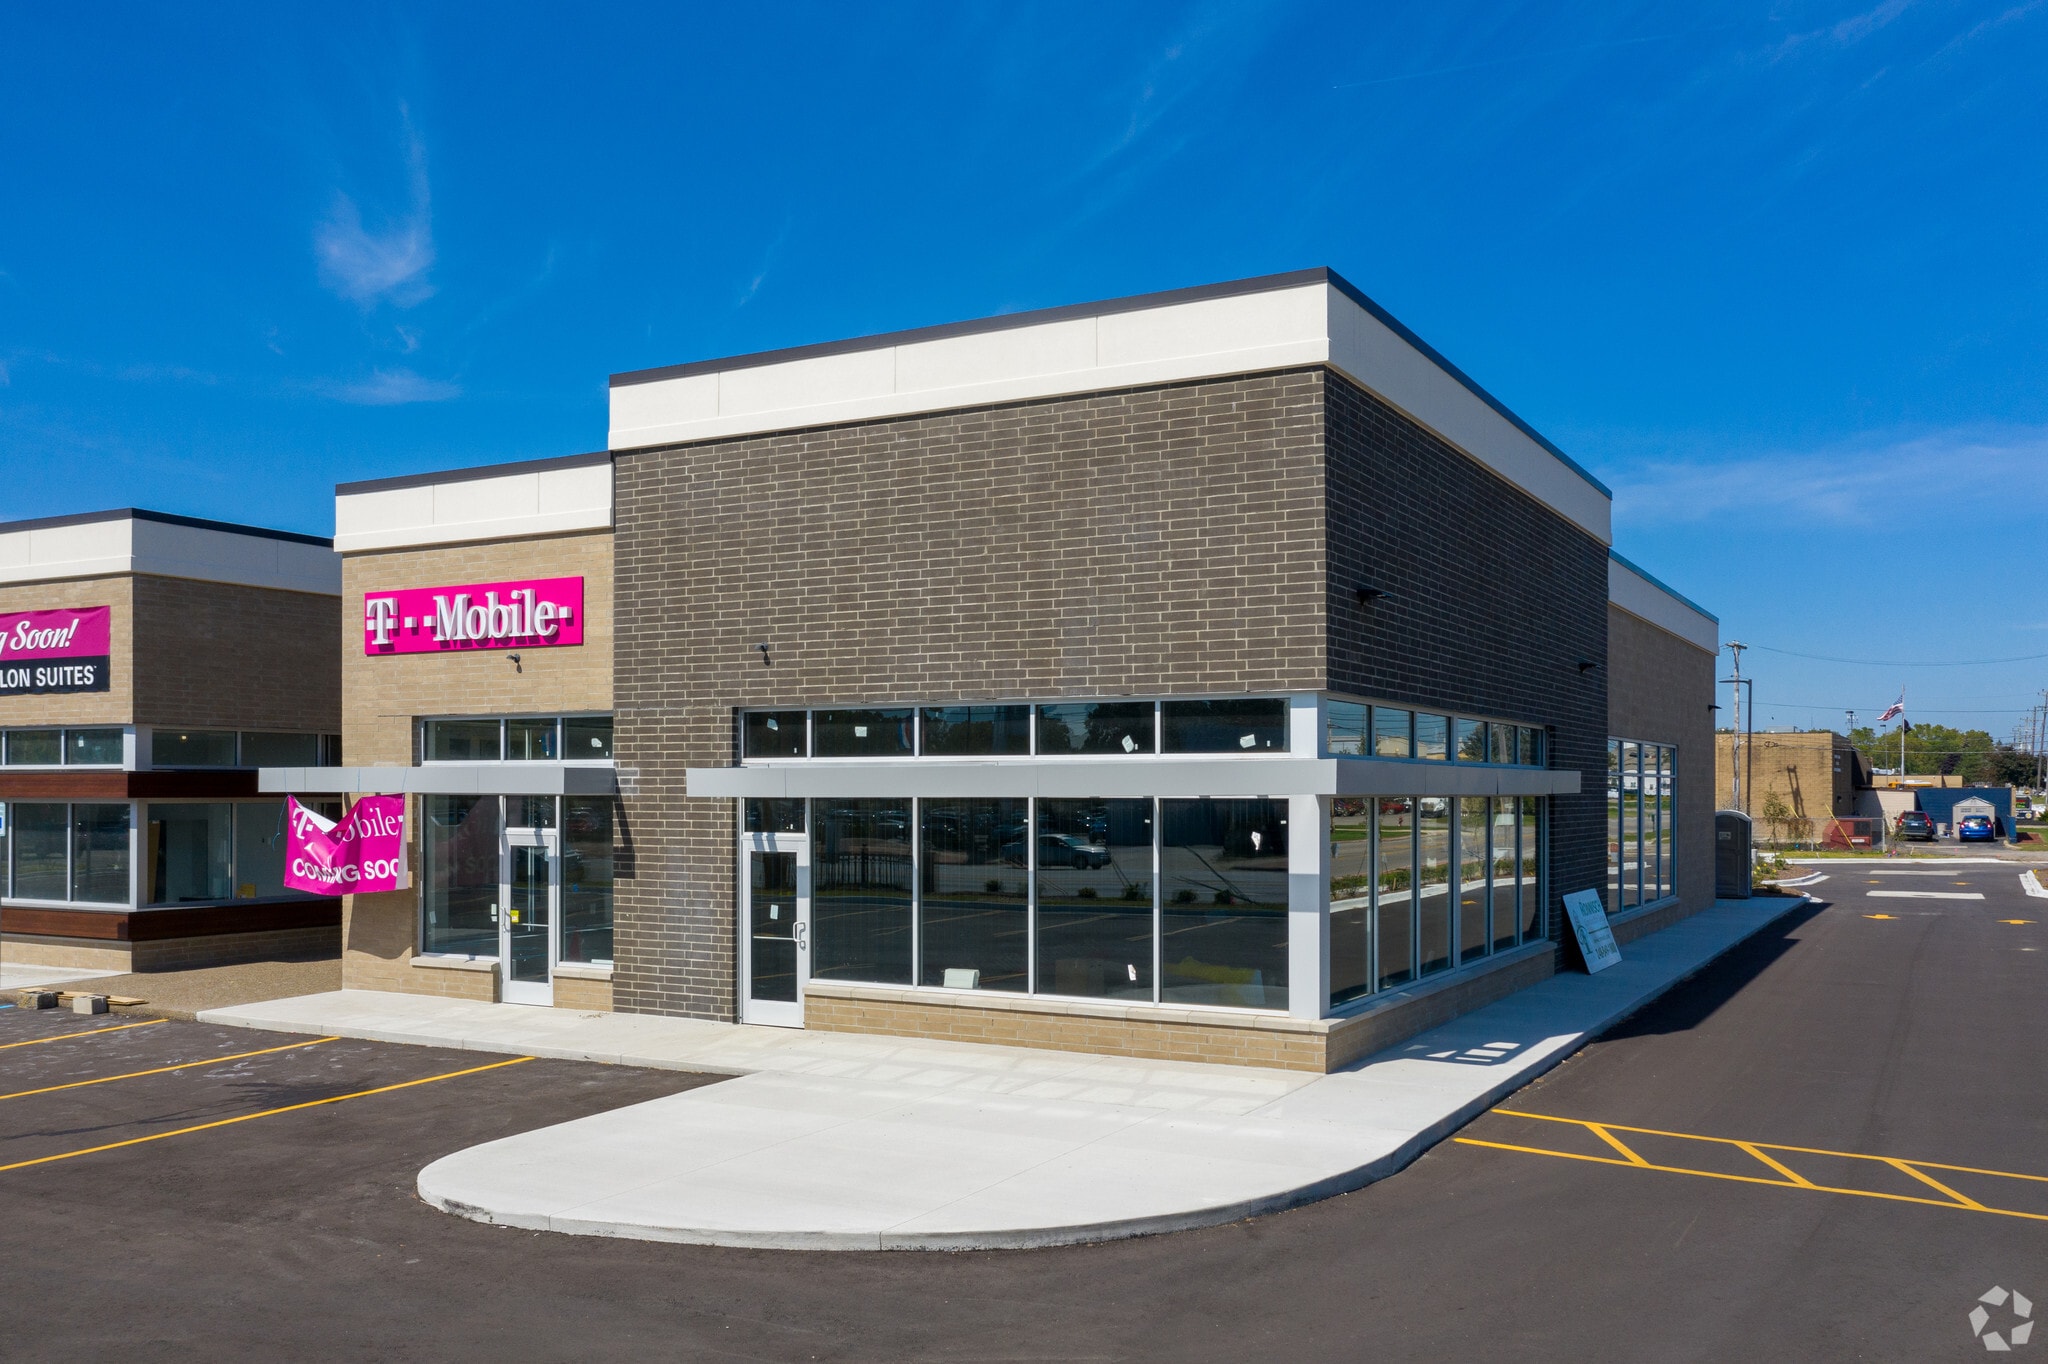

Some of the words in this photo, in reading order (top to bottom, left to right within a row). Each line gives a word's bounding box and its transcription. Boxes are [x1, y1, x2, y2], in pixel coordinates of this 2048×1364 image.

[9, 618, 79, 650] Soon!
[0, 668, 30, 688] LON
[363, 858, 399, 880] SOO
